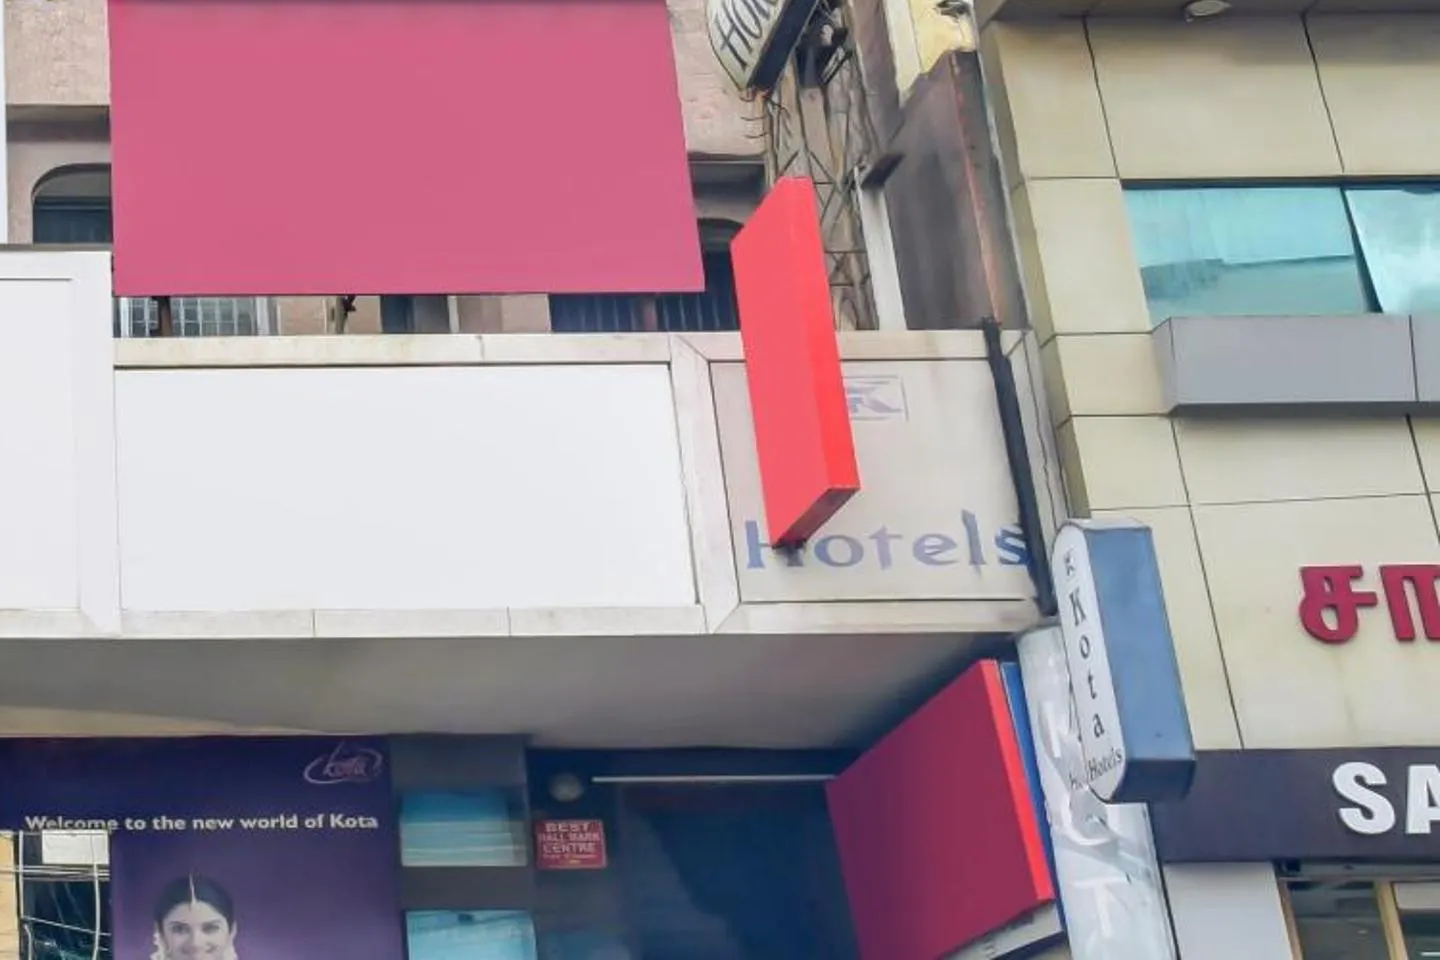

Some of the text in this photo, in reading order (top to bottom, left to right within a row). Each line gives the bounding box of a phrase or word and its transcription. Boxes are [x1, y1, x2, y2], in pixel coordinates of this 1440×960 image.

[25, 814, 378, 831] Welcome to the new world of Kota
